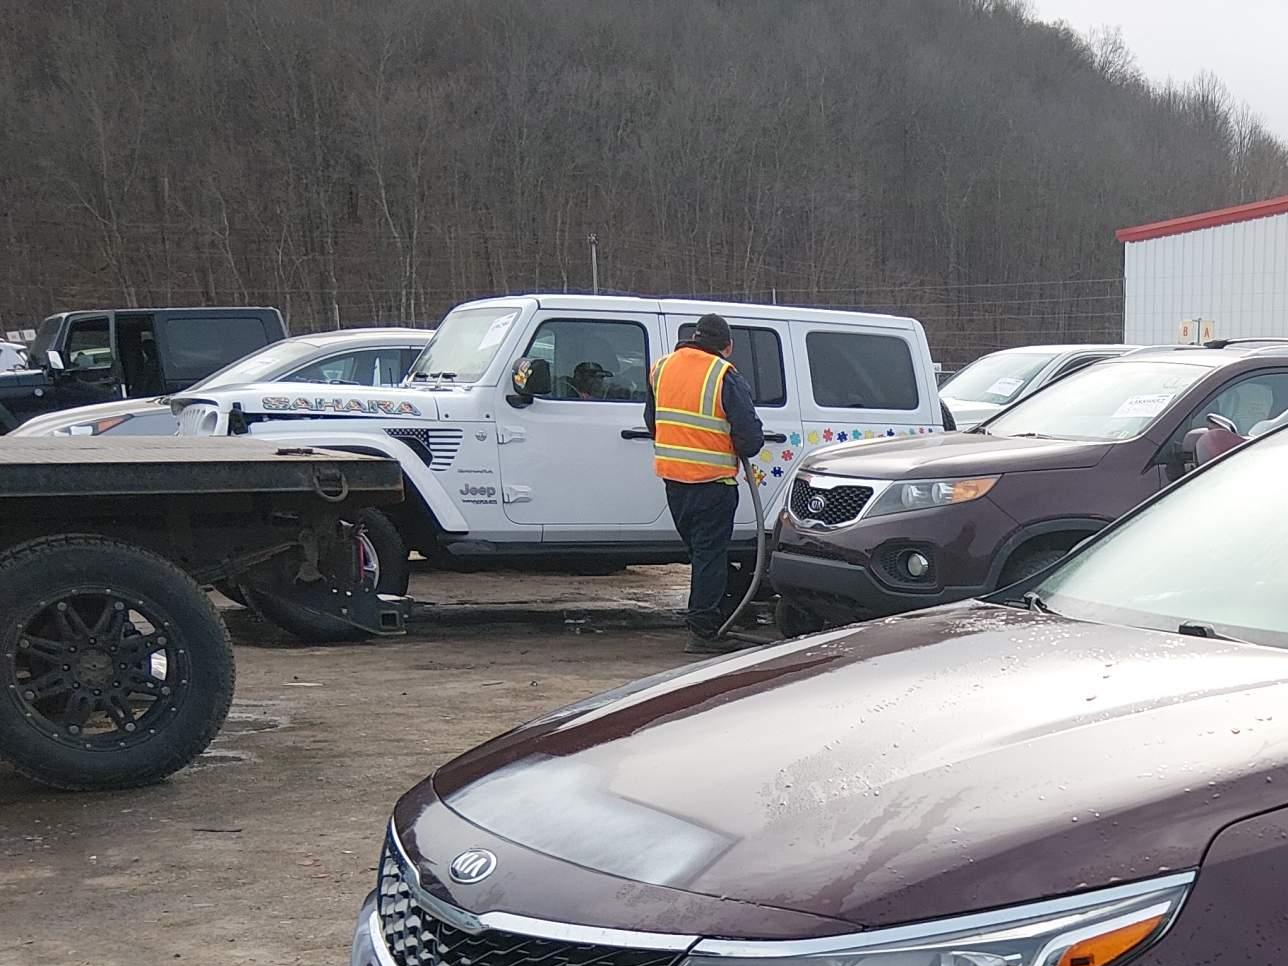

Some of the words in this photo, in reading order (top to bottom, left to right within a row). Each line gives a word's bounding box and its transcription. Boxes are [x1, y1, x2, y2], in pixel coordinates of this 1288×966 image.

[1183, 326, 1188, 337] B
[1203, 327, 1210, 338] A
[262, 397, 421, 417] SAHARA
[459, 483, 496, 498] Jeep
[452, 852, 487, 878] KIA
